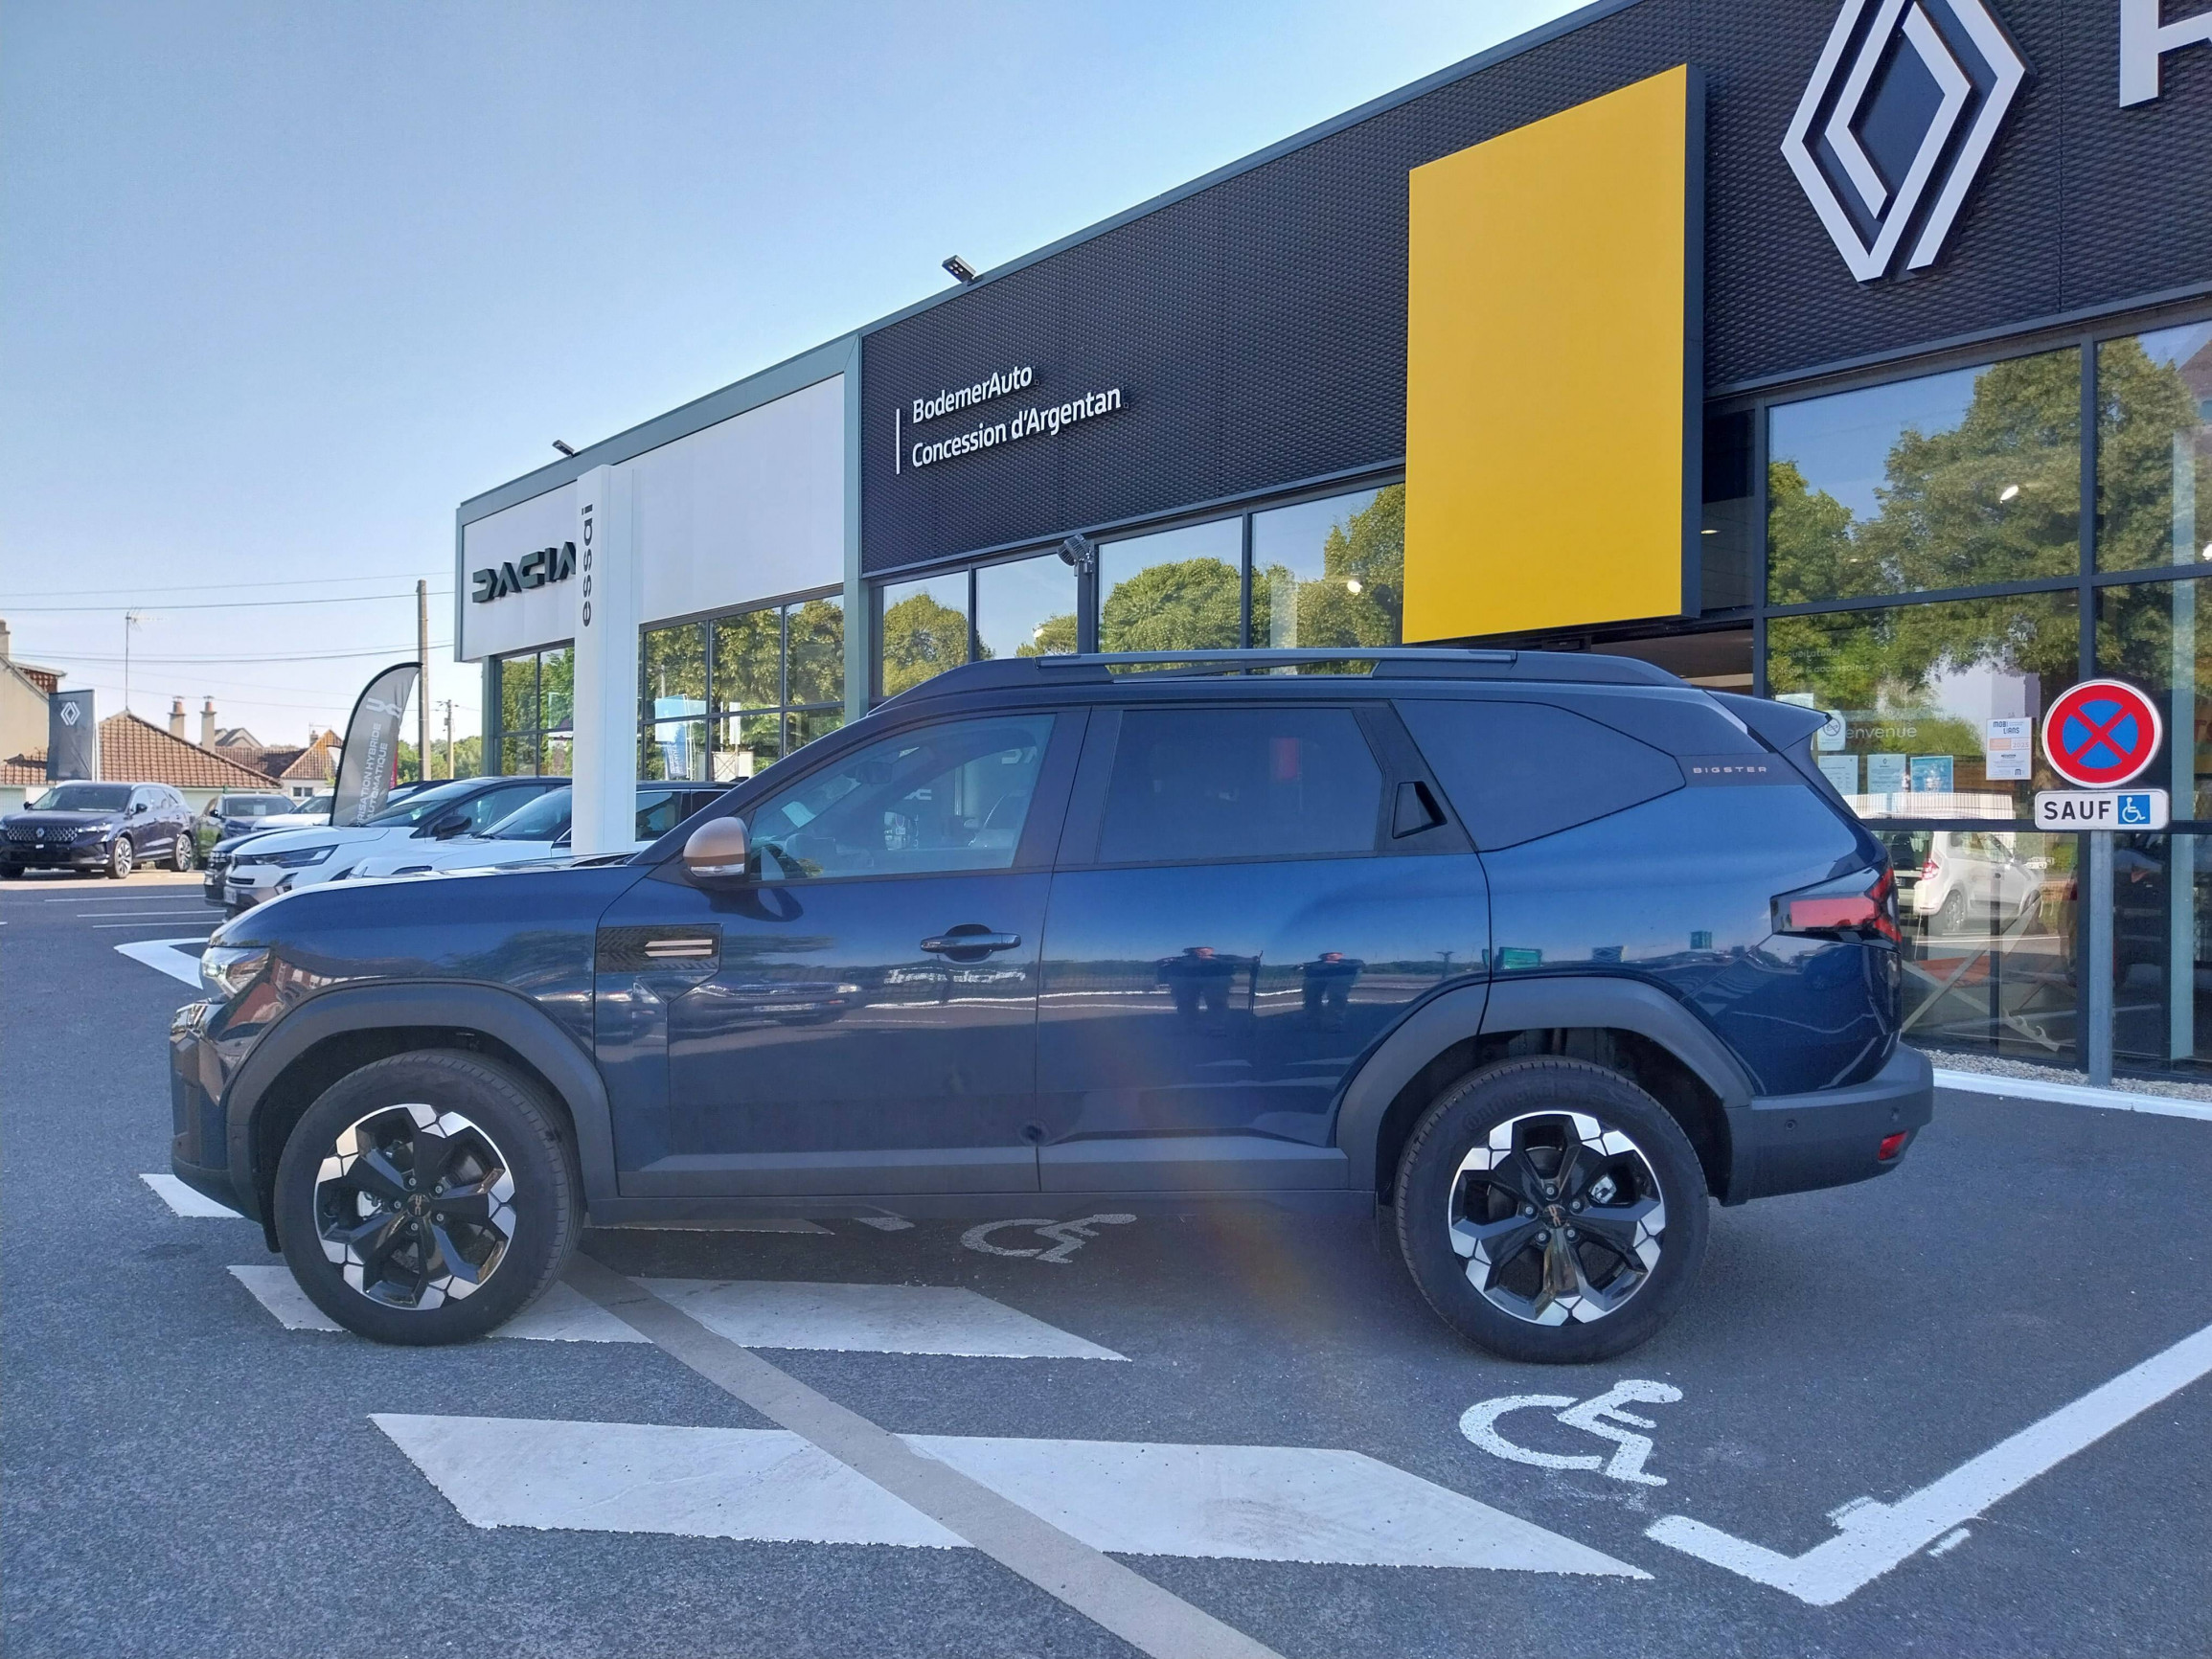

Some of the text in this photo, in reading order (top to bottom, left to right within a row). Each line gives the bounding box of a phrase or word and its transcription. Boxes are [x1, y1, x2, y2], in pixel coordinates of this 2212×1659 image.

[912, 366, 1033, 423] BodemerAuto
[912, 388, 1122, 467] Concession d'Argentan
[471, 541, 577, 604] DACIA
[582, 504, 593, 627] essai
[366, 722, 381, 773] HYBRIDE
[1846, 727, 1917, 739] envenue
[2043, 800, 2111, 820] SAUF
